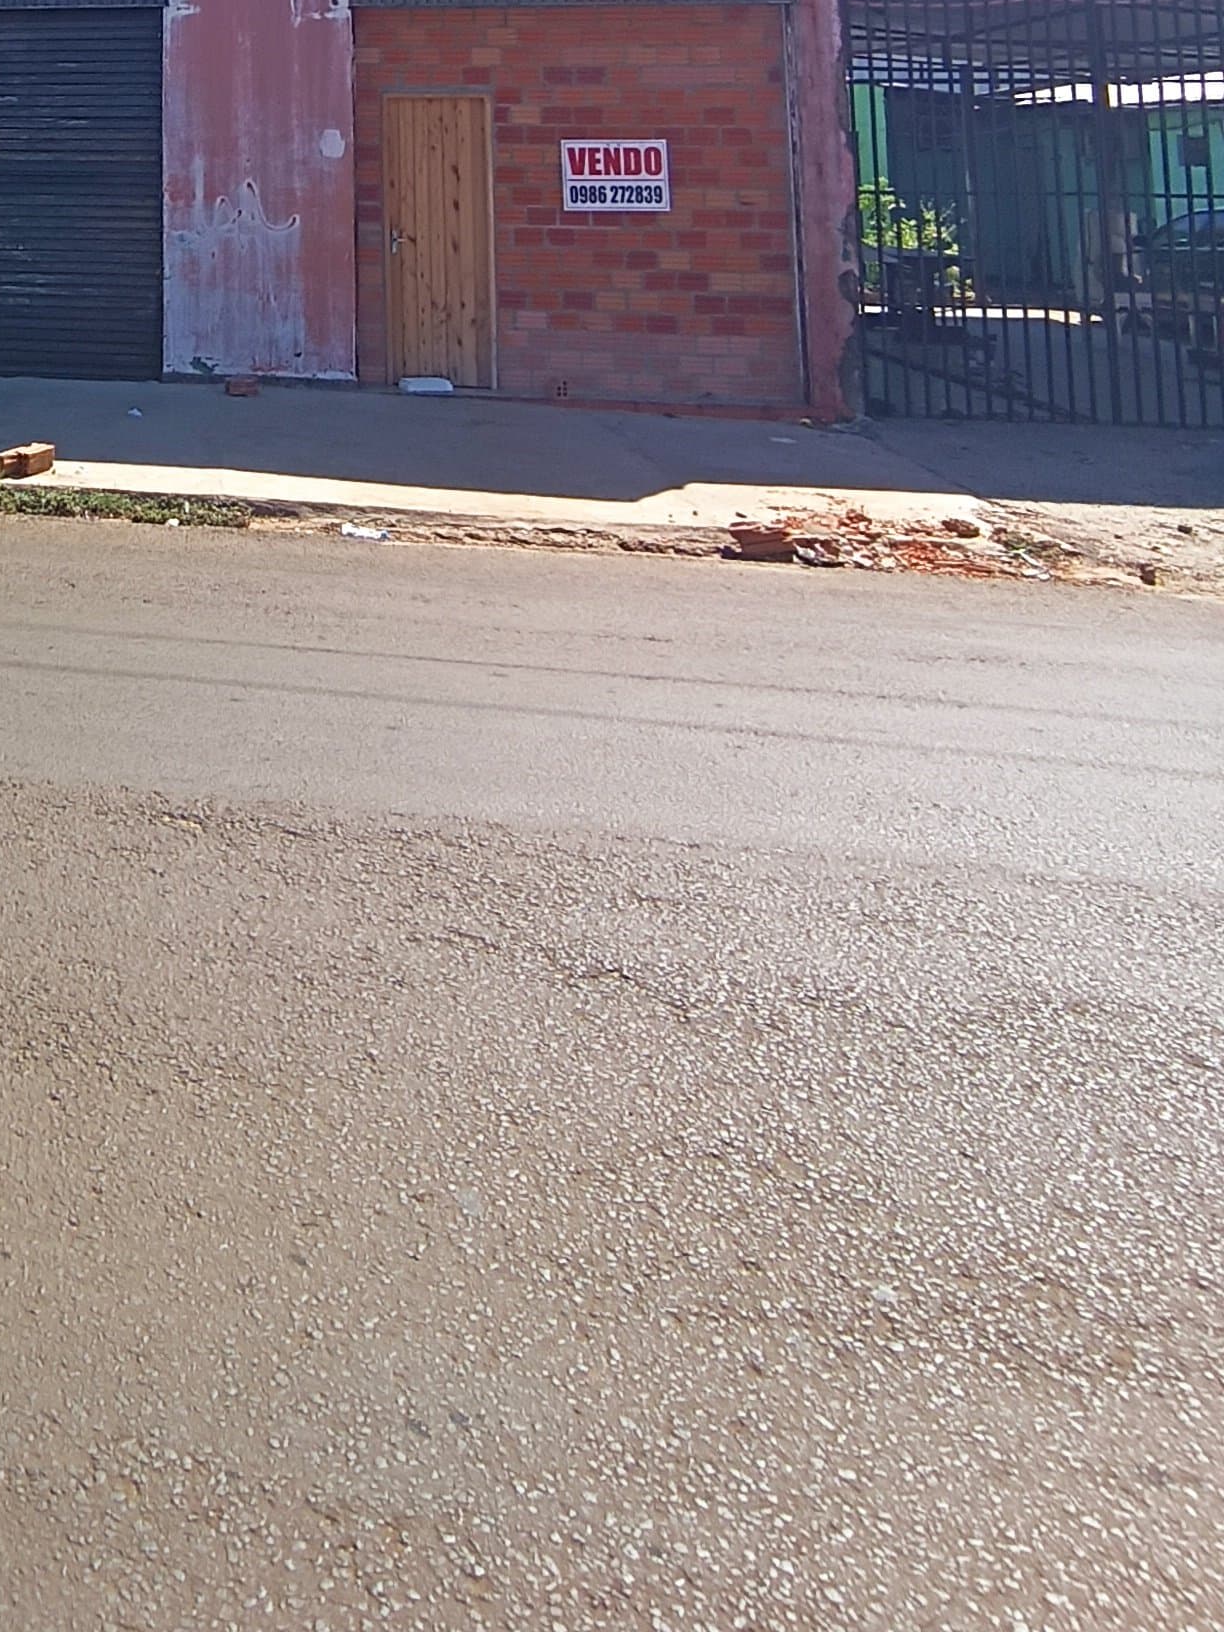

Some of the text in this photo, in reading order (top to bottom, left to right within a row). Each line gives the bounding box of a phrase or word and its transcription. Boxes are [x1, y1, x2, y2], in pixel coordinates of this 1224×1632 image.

[567, 147, 662, 176] VENDO
[570, 185, 663, 204] 0986 272839
